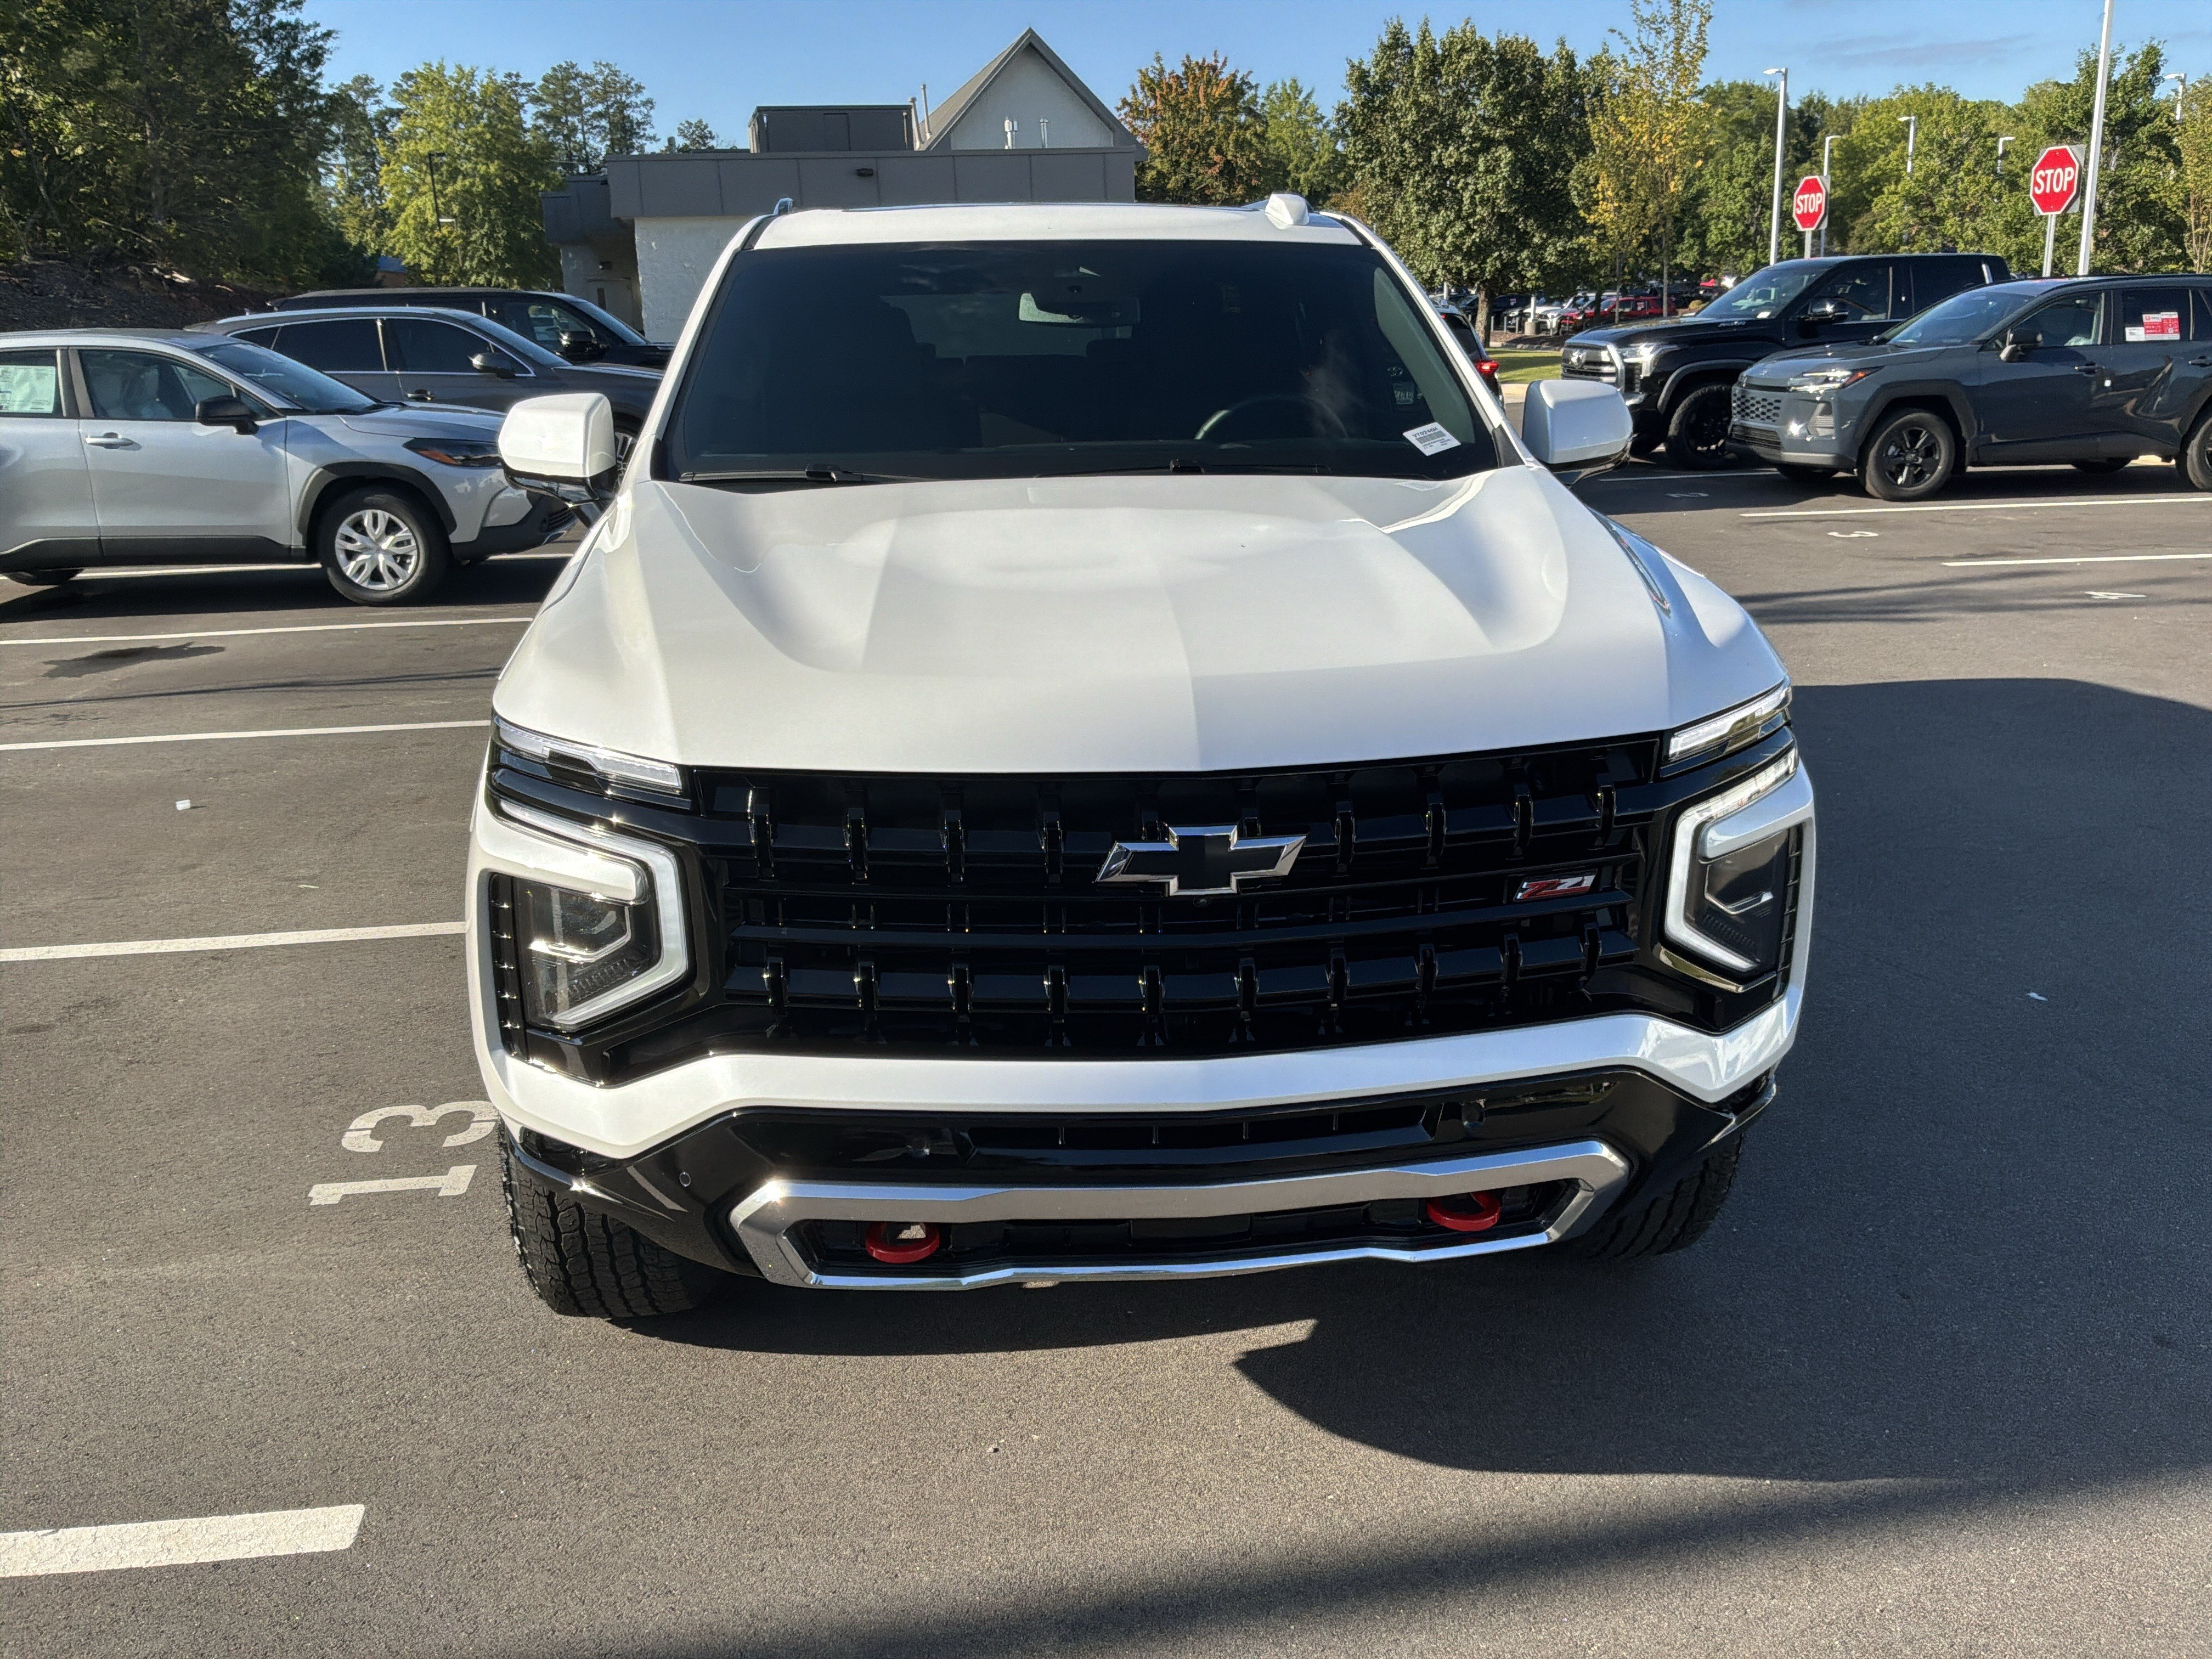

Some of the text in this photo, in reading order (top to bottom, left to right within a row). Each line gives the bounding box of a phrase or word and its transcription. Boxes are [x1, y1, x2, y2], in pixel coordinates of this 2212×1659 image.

[2034, 167, 2073, 194] STOP
[1796, 193, 1822, 215] STOP
[1514, 874, 1596, 899] Z71
[308, 1100, 499, 1206] 13
